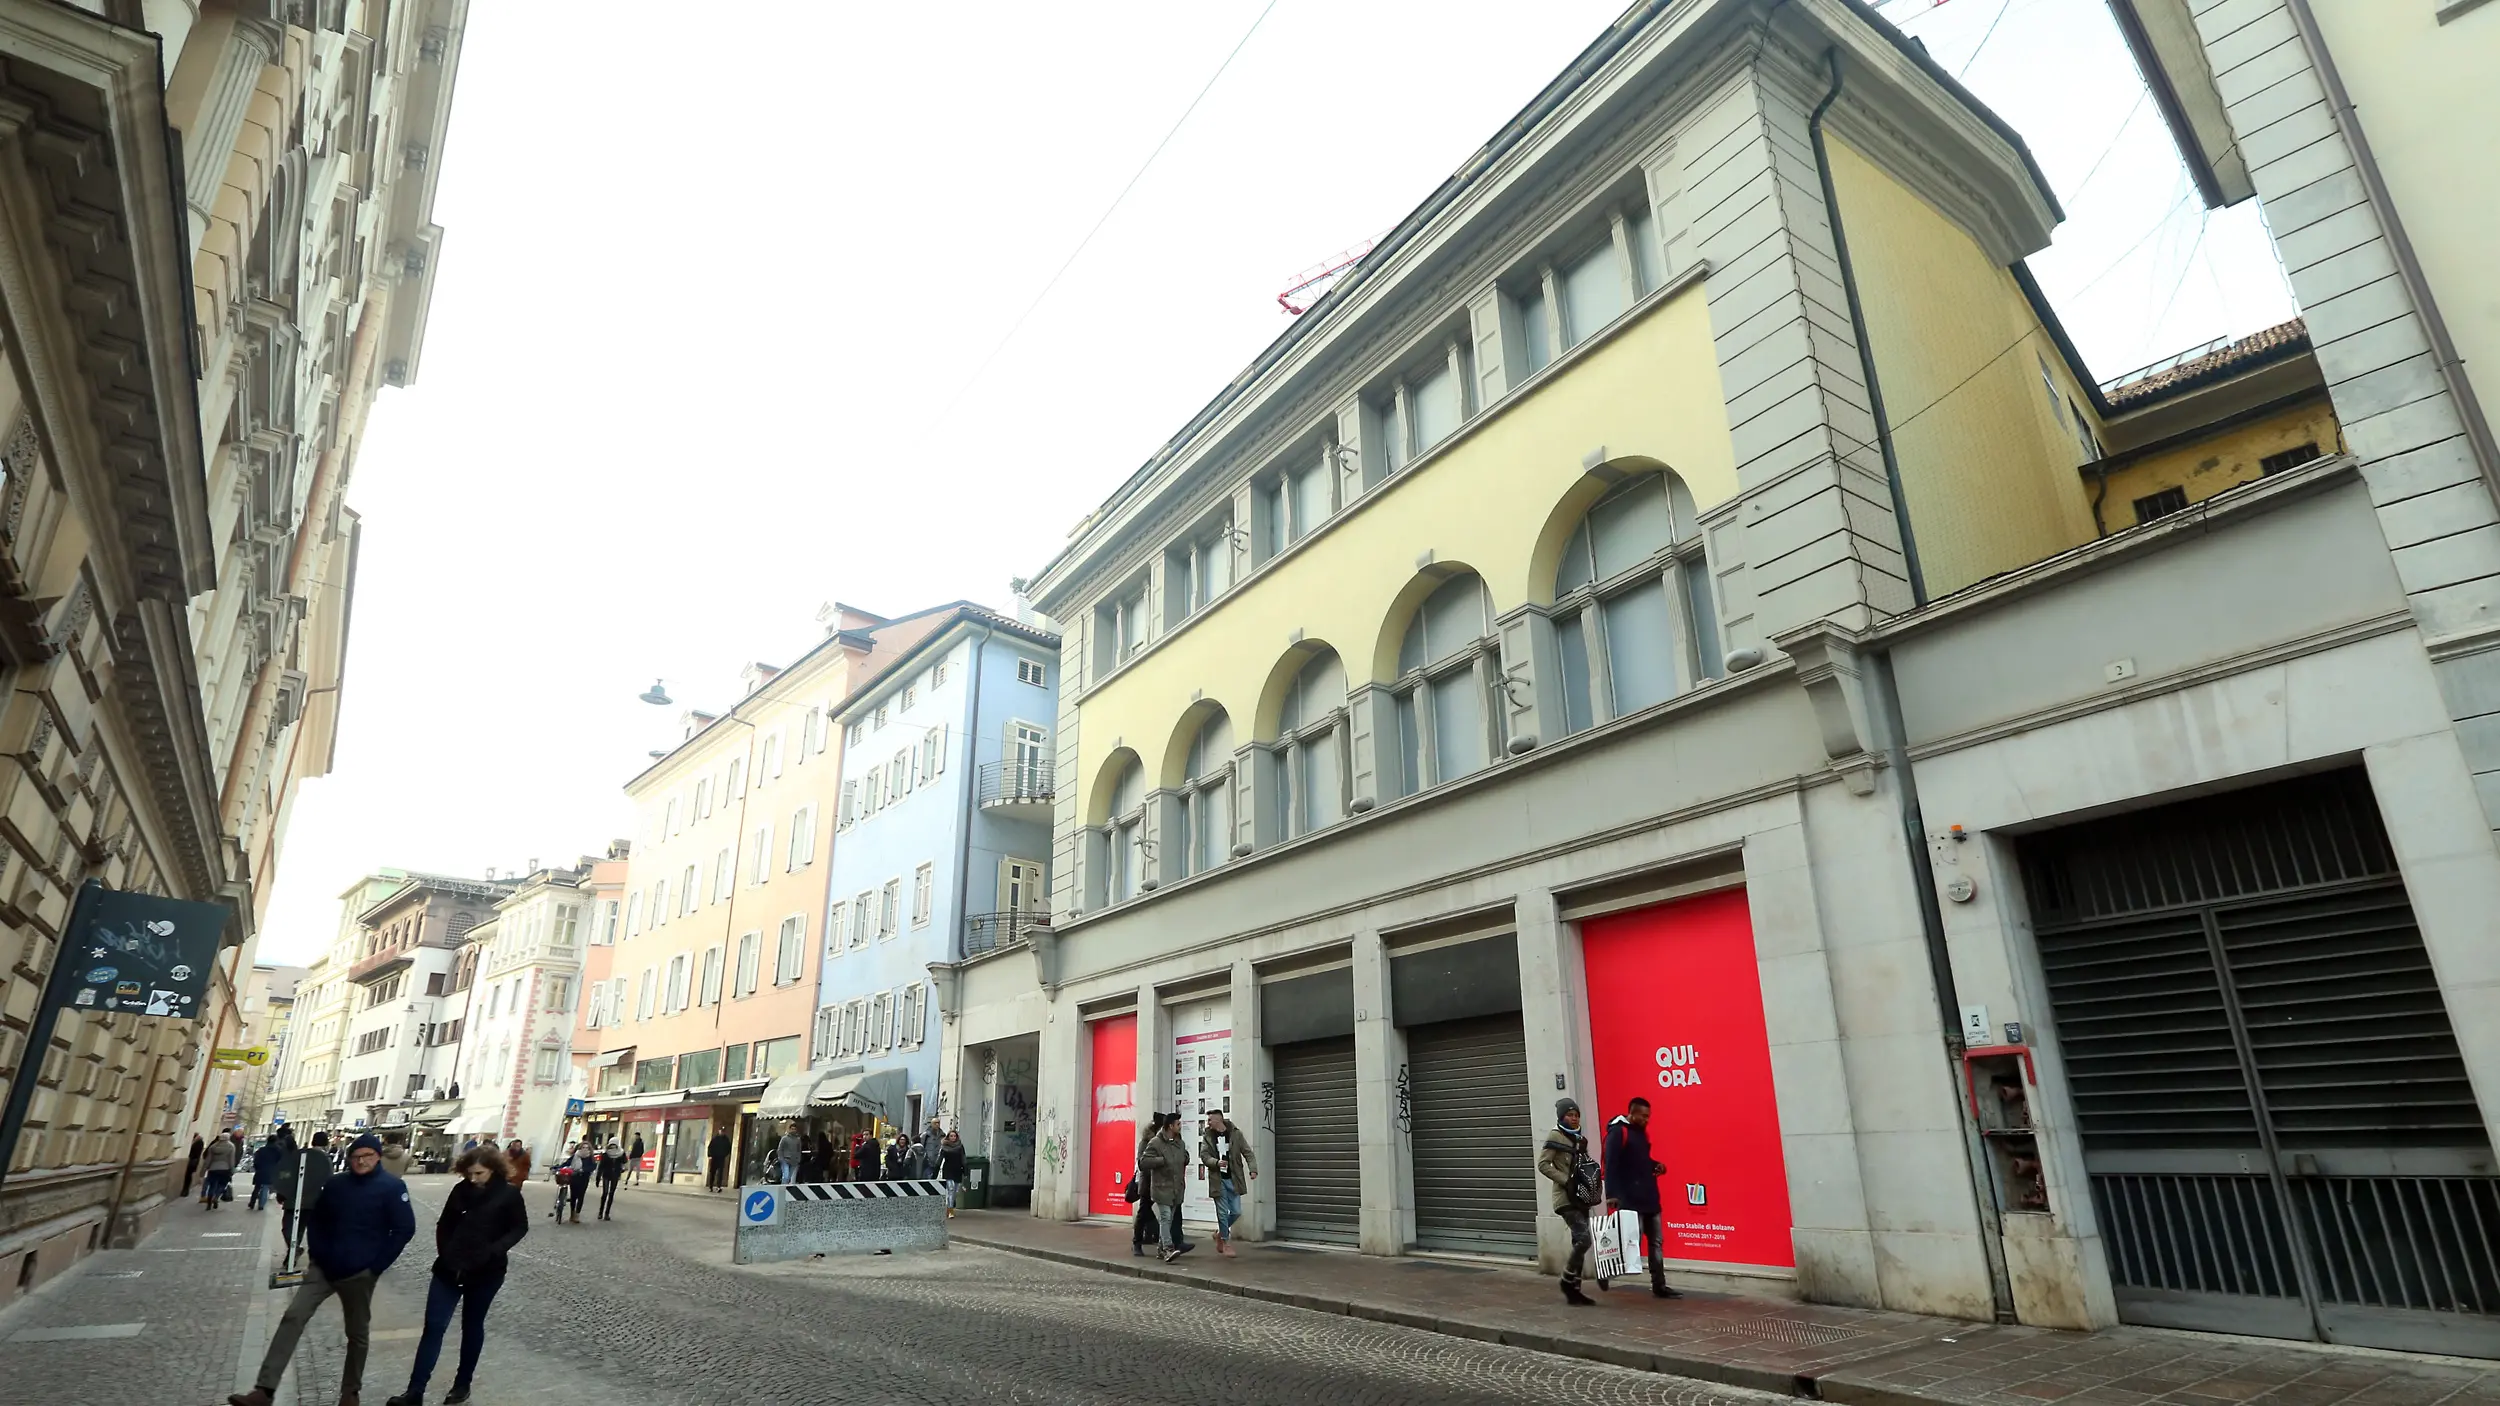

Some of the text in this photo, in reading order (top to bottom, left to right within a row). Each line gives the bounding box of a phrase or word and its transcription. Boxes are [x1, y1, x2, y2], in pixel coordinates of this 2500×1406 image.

[2115, 665, 2122, 675] 2
[248, 1051, 265, 1060] PT
[1658, 1067, 1702, 1088] ORA
[1667, 1221, 1685, 1230] Teatro
[1685, 1222, 1705, 1231] Stabile
[1712, 1223, 1735, 1232] Bolzano
